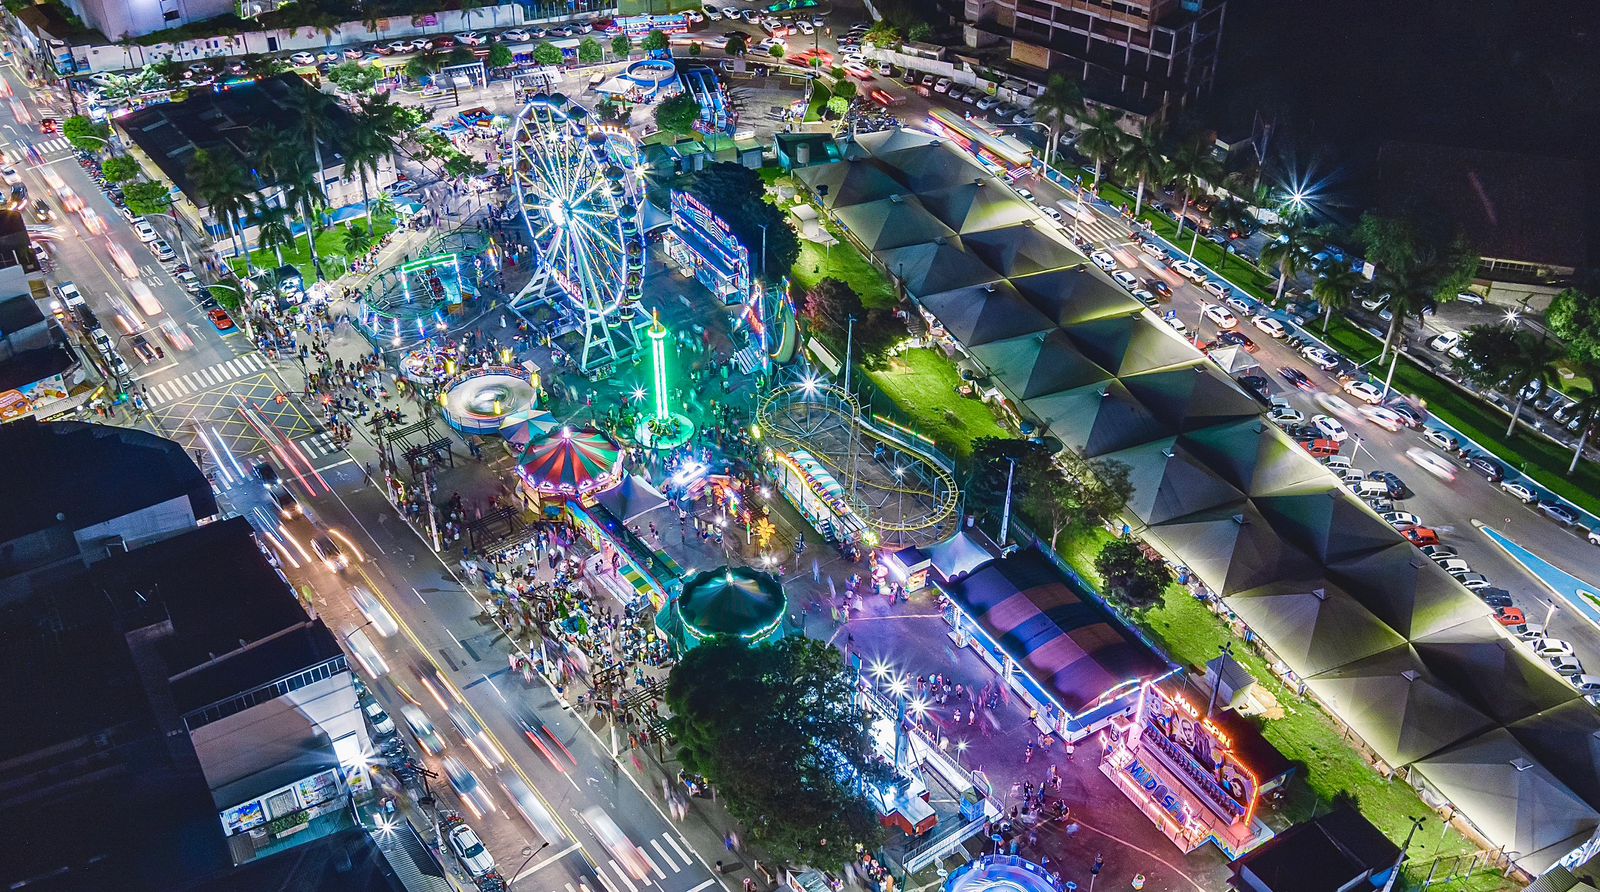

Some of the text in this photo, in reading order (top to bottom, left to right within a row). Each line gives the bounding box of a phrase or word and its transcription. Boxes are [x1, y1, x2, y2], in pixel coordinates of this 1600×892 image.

[1174, 691, 1232, 749] MAD SPIN
[1124, 759, 1158, 791] MAD
